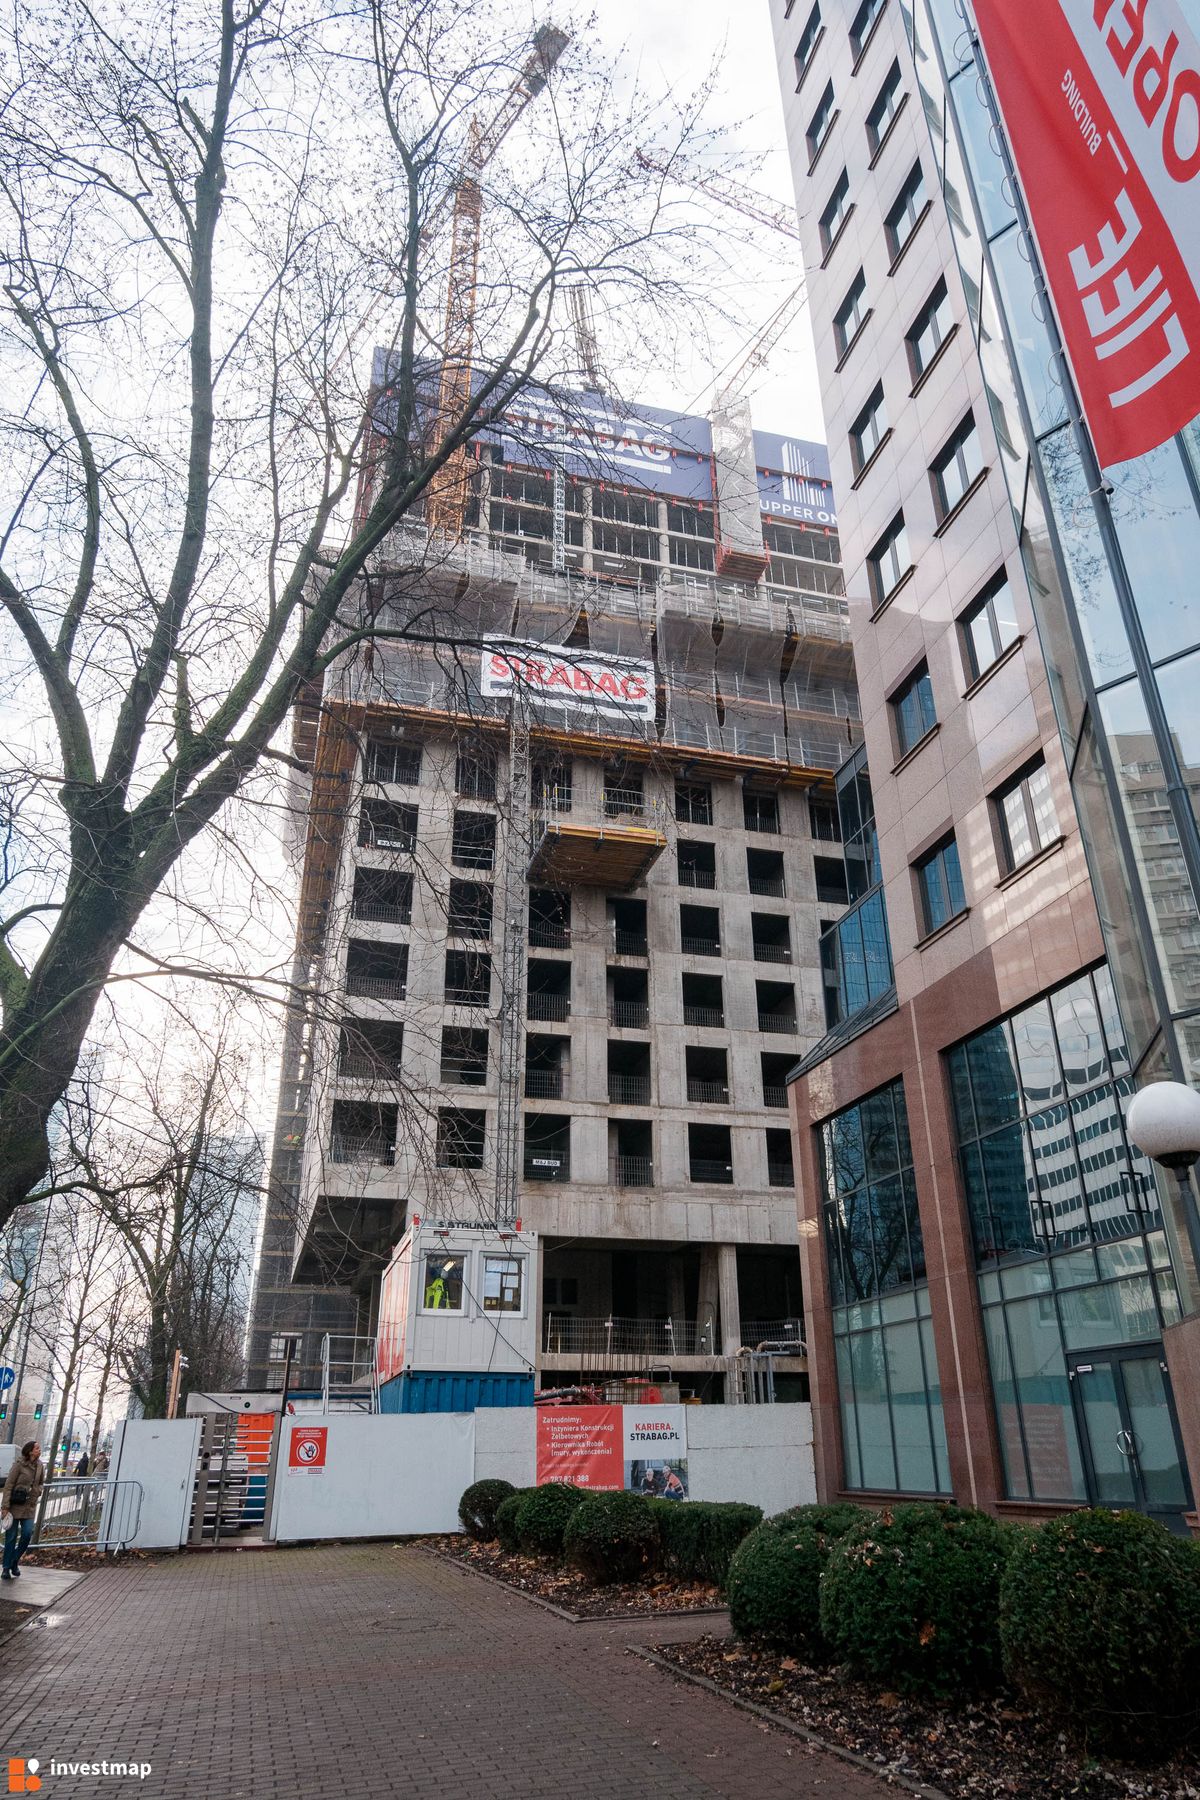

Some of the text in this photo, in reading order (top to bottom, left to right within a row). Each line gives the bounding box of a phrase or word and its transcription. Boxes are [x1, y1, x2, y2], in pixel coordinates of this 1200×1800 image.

[1061, 68, 1190, 409] LIFE BUILDING
[760, 499, 814, 520] UPPER
[490, 655, 647, 700] STRABAG
[580, 1424, 614, 1432] Konstrukcji
[635, 1423, 674, 1431] KARIERA.
[630, 1432, 680, 1440] STRABAG.PL
